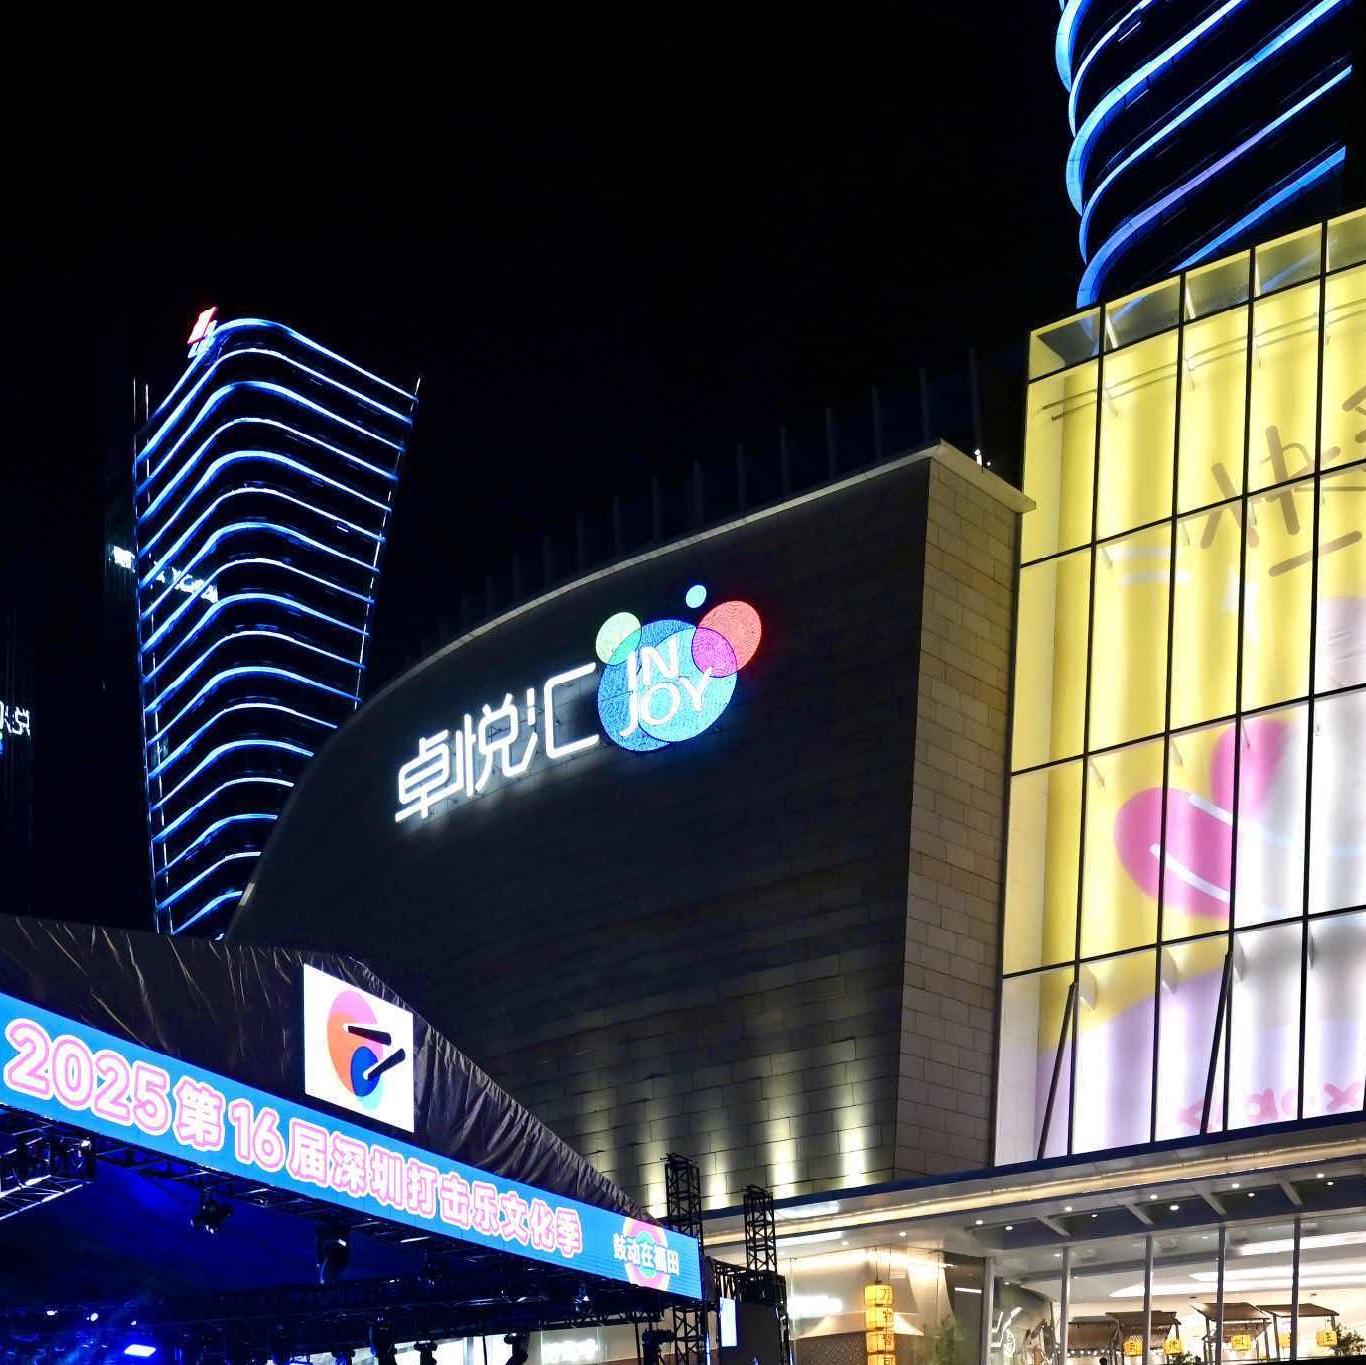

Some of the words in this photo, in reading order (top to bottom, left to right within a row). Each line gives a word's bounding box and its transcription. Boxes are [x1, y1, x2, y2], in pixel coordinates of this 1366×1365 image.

[627, 634, 678, 690] IN
[619, 667, 713, 737] JOY
[394, 661, 600, 823] 卓悦汇
